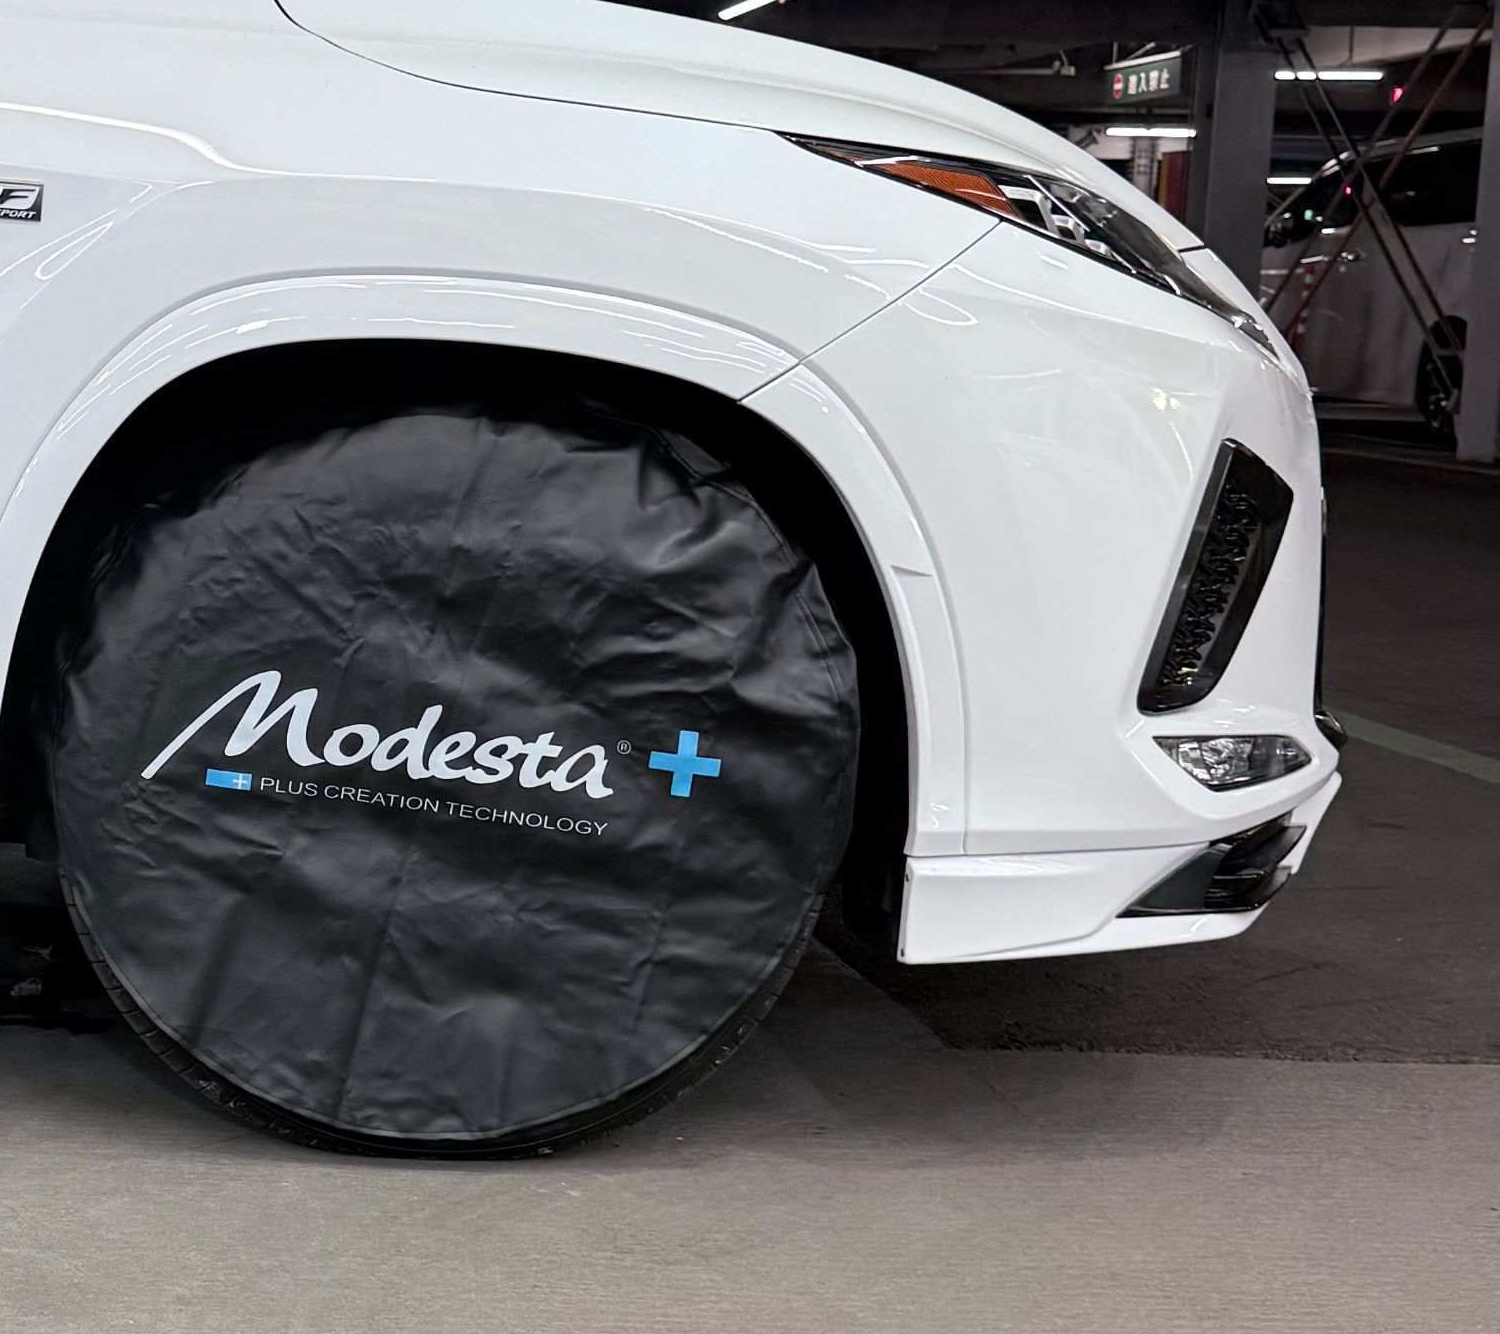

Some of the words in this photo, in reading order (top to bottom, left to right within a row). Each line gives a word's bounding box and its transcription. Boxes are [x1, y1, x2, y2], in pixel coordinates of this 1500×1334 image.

[141, 670, 614, 799] Modesta
[260, 776, 318, 798] PLUS
[323, 784, 439, 813] CREATION
[446, 800, 608, 837] TECHNOLOGY
